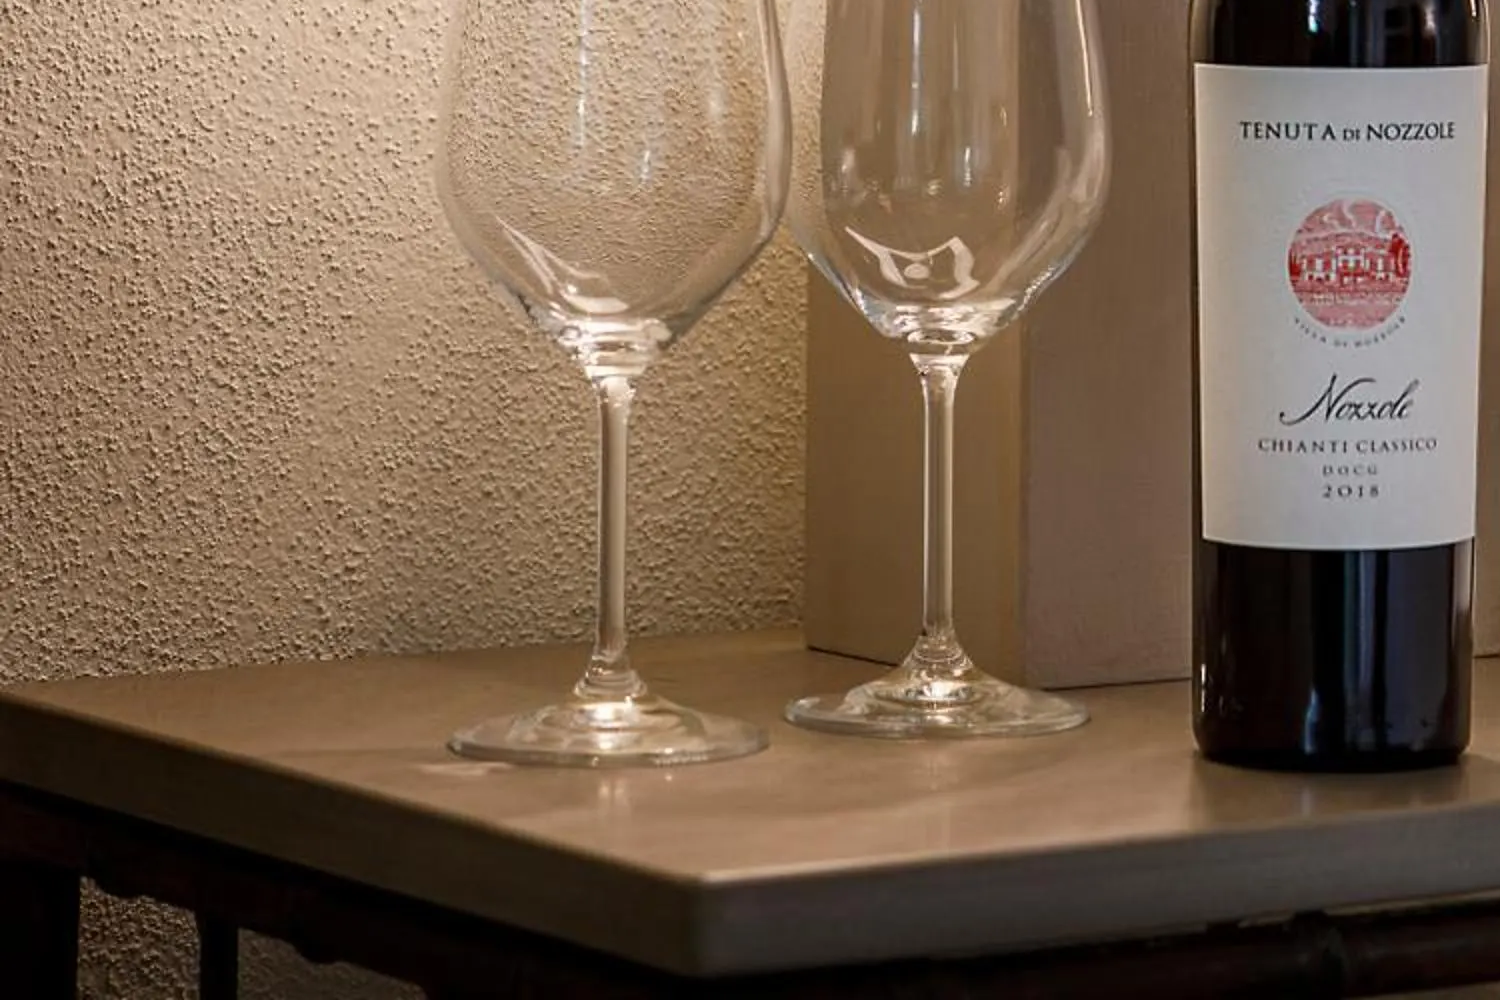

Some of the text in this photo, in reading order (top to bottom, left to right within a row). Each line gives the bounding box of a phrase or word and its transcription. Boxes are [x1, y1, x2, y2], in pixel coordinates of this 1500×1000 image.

[1239, 120, 1336, 142] TENUTA
[1366, 120, 1456, 142] NOZZOLE
[1278, 372, 1420, 427] Nozzole
[1258, 437, 1438, 455] CHIANTI CLASSICO
[1322, 484, 1379, 499] 2018
